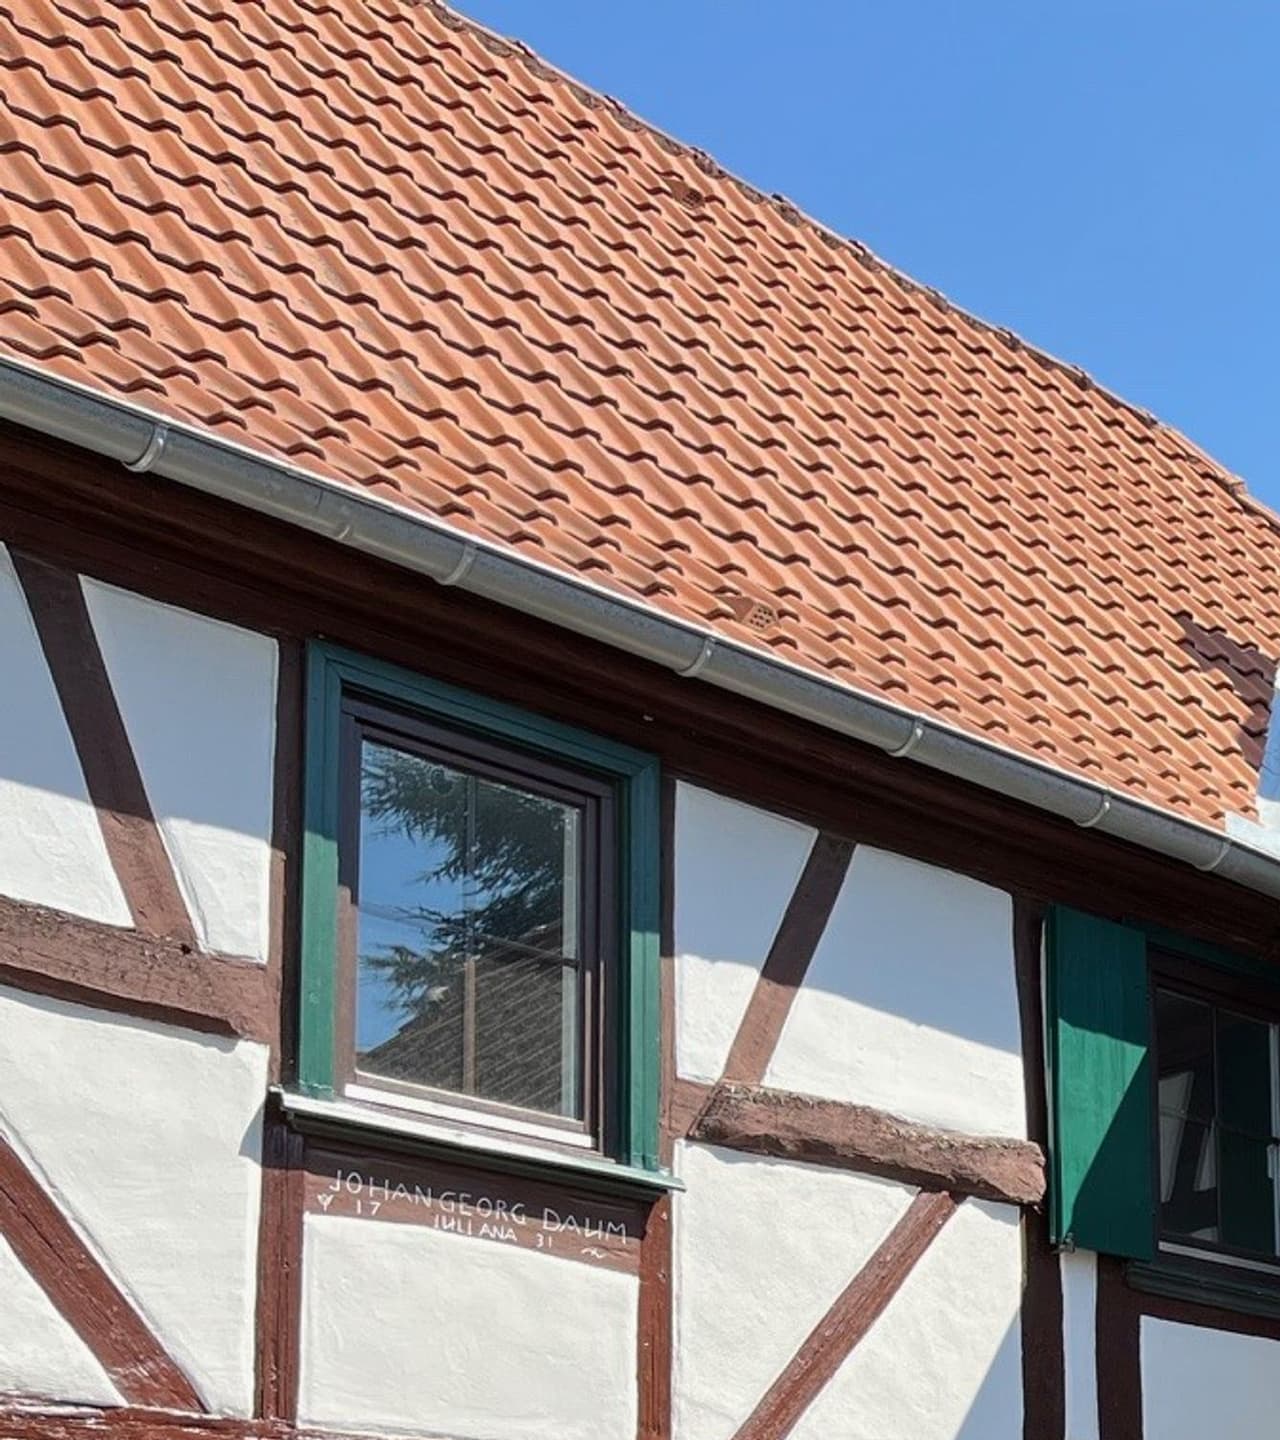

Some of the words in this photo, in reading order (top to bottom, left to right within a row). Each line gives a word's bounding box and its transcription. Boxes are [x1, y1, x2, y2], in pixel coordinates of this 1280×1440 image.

[356, 1200, 381, 1215] 17
[535, 1232, 552, 1249] 31
[543, 1207, 627, 1245] DAUM
